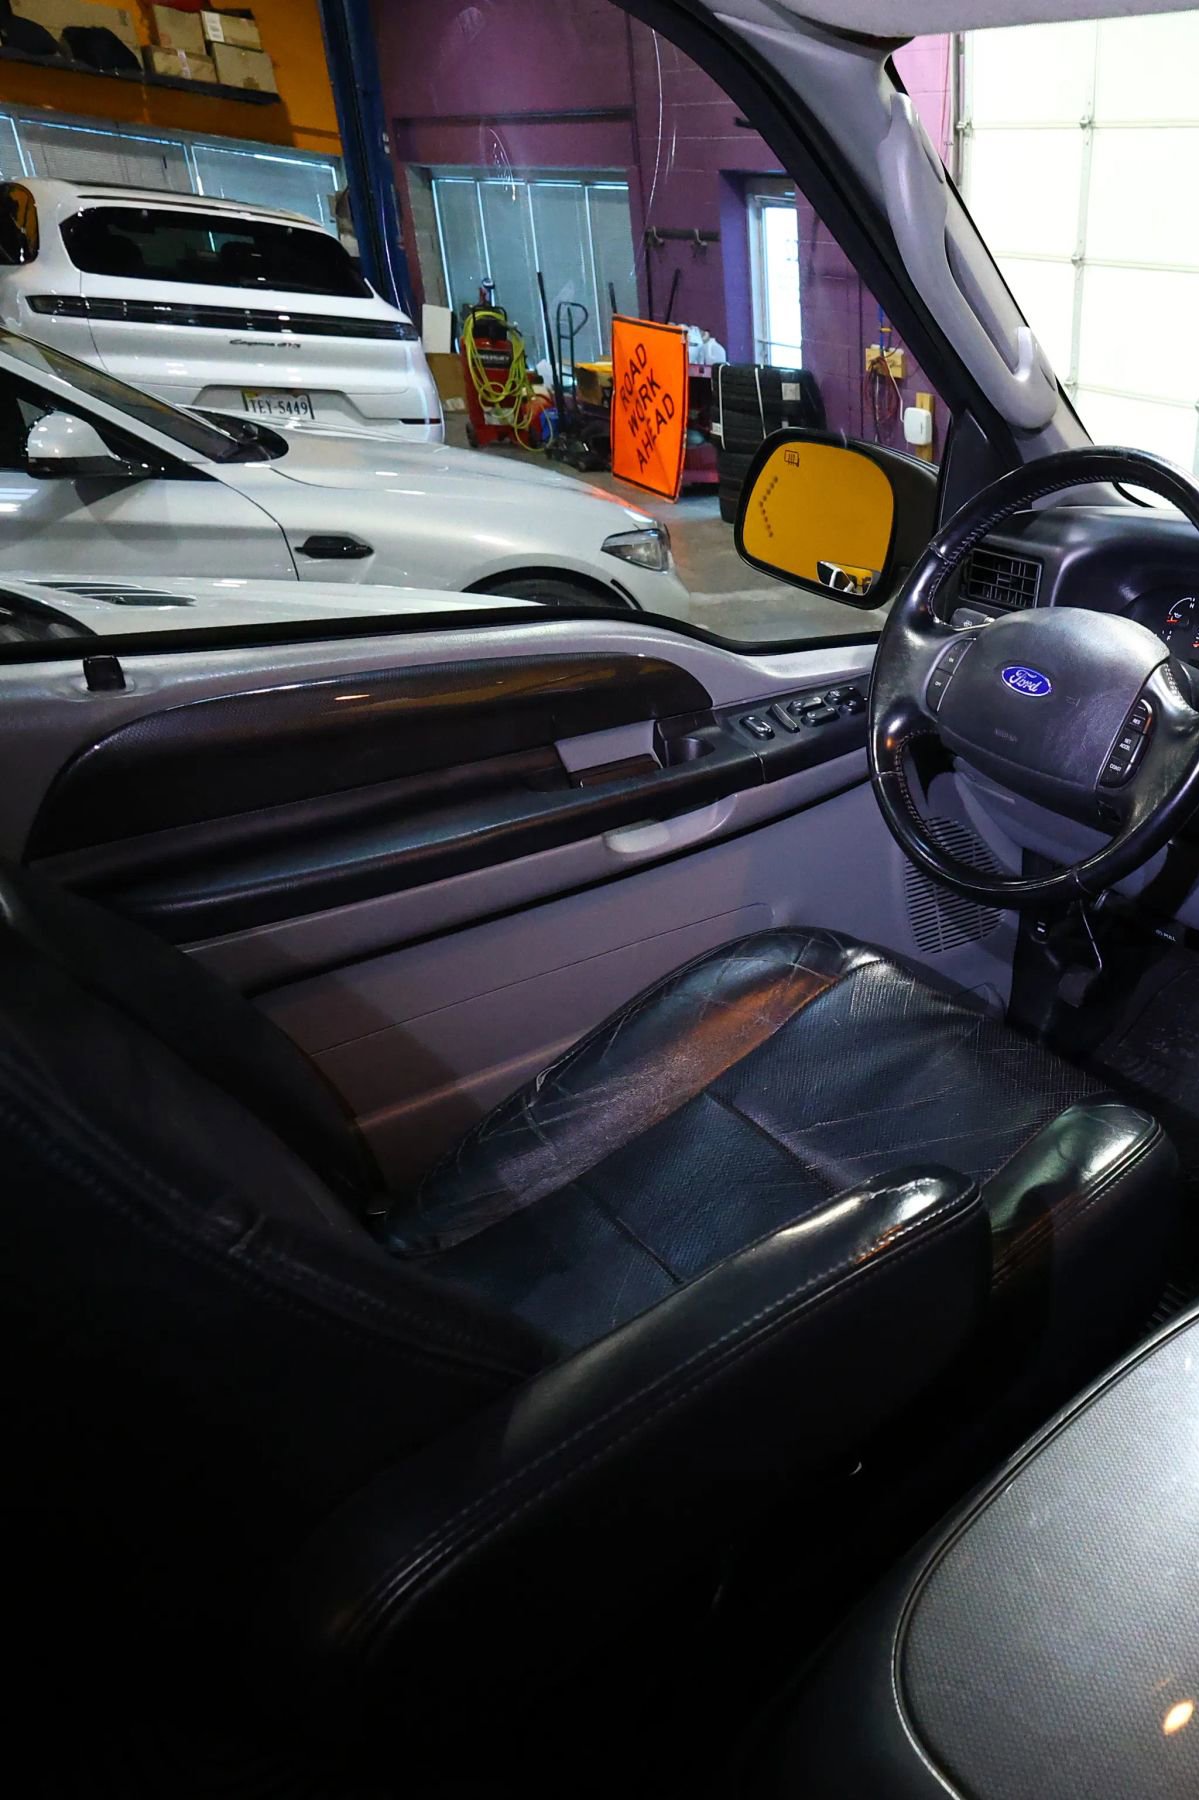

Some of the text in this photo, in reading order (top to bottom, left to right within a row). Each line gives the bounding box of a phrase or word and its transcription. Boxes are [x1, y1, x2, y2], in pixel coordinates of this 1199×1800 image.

[249, 399, 309, 415] TEY-5449
[619, 342, 648, 412] ROAD
[627, 368, 661, 438] WORK
[635, 393, 676, 474] AHEAD
[1009, 669, 1043, 693] Ford
